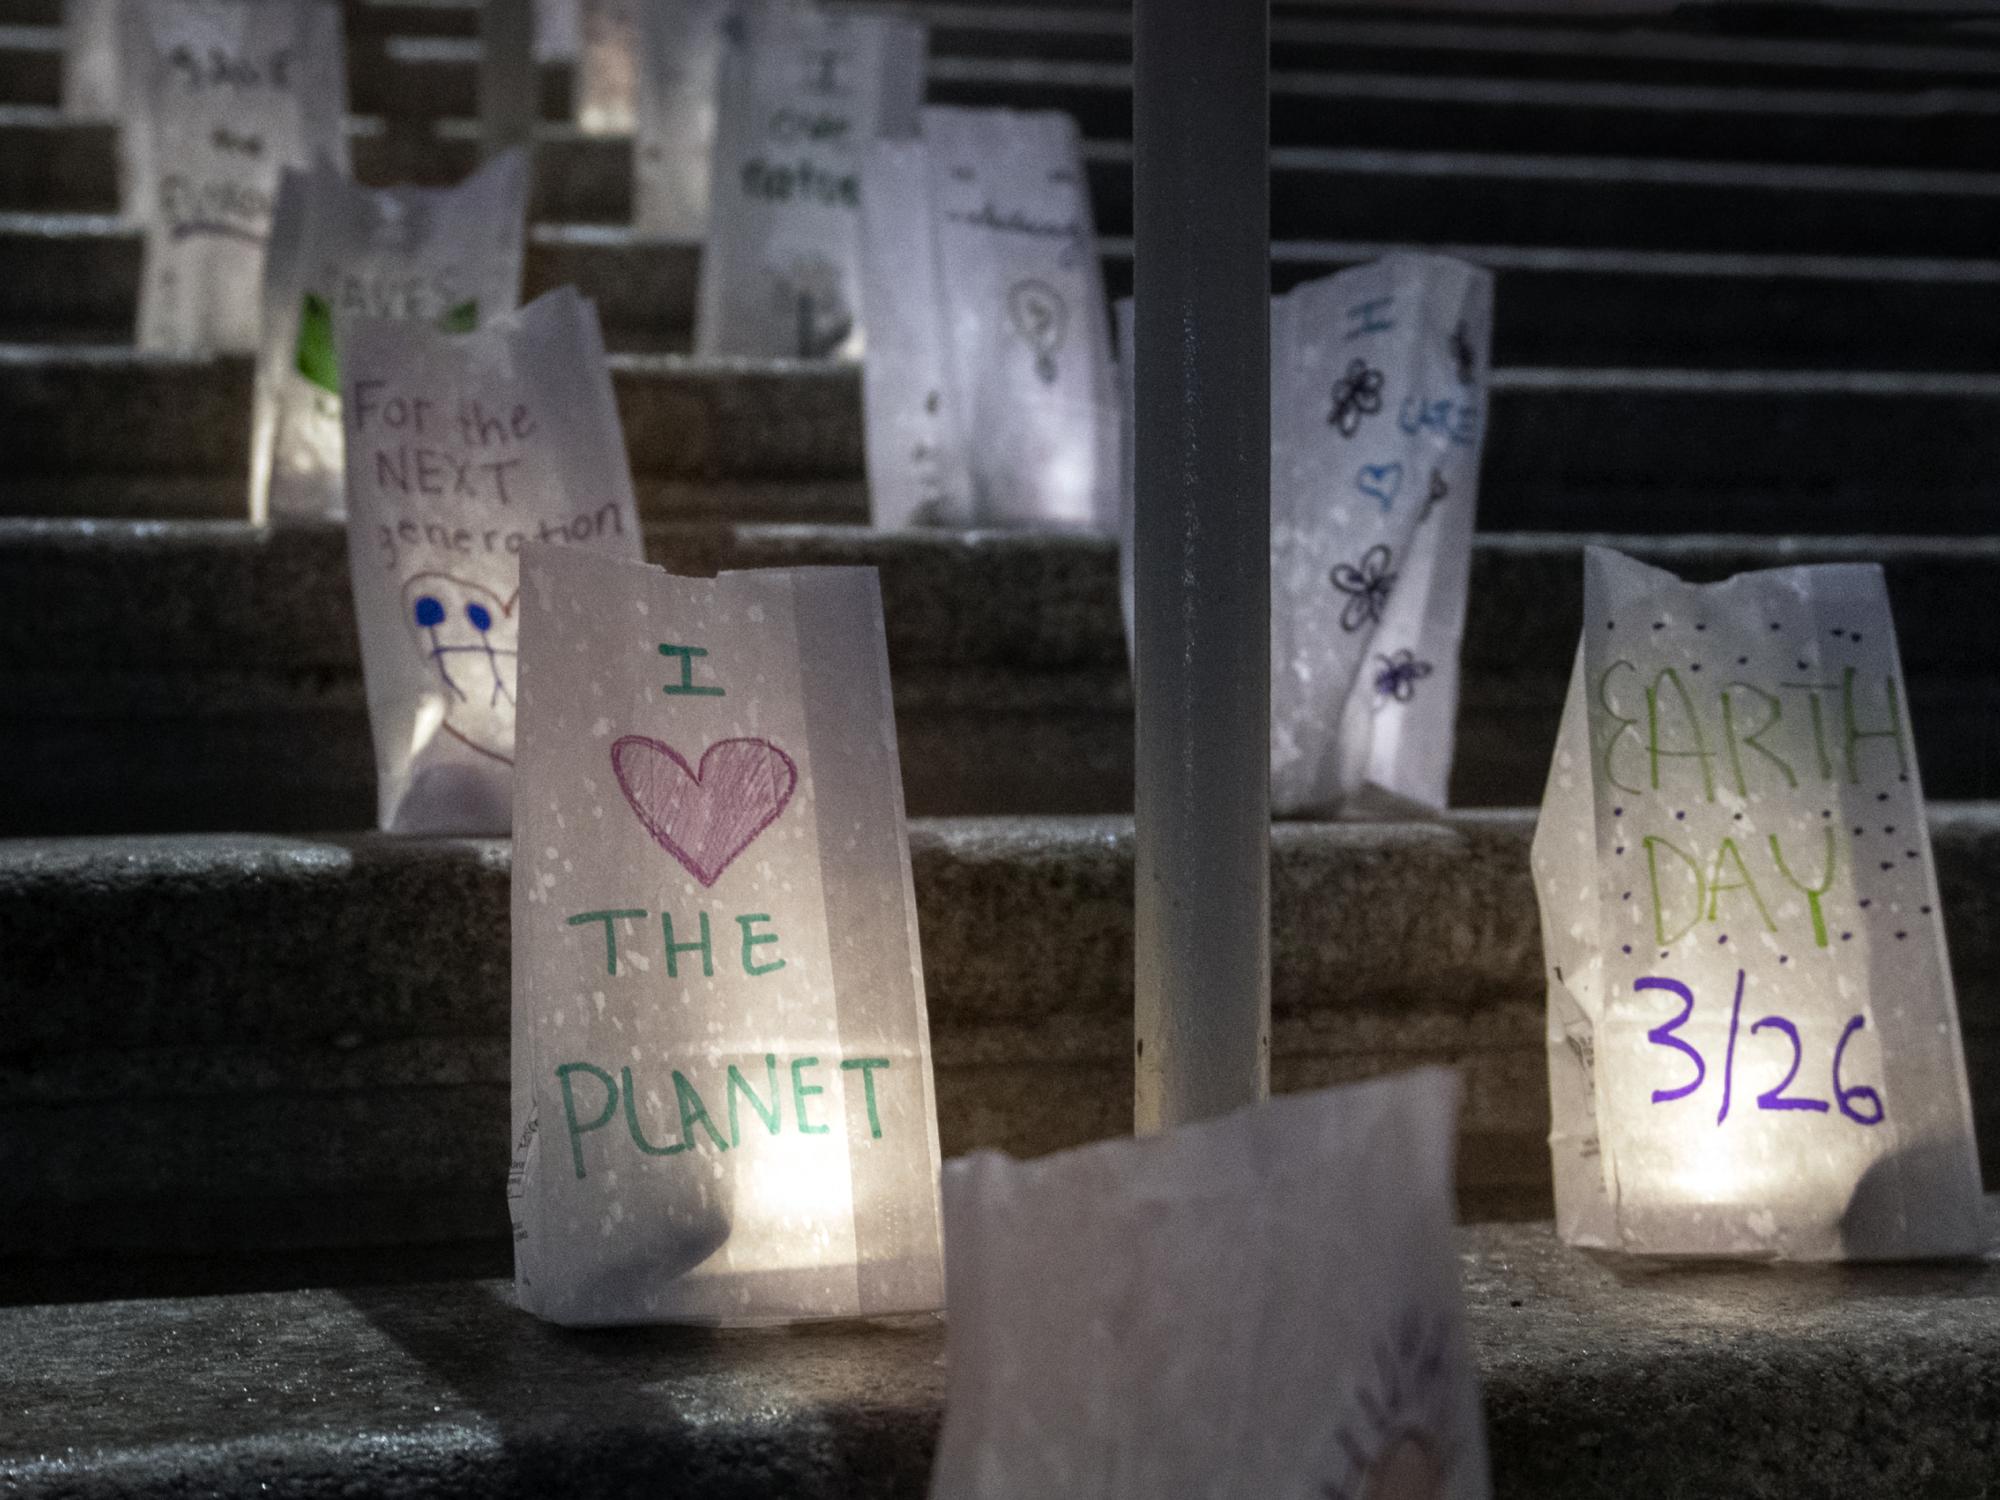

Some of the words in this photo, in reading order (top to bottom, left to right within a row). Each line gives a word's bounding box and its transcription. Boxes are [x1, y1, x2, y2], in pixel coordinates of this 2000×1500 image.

[355, 379, 435, 432] For
[458, 402, 535, 447] the
[375, 450, 520, 504] NEXT
[378, 501, 624, 571] generation
[658, 643, 726, 696] I
[1601, 659, 1899, 802] EARTH
[1642, 826, 1837, 948] DAY
[567, 908, 787, 977] THE
[1634, 969, 1885, 1126] 3/26
[556, 1053, 890, 1179] PLANET
